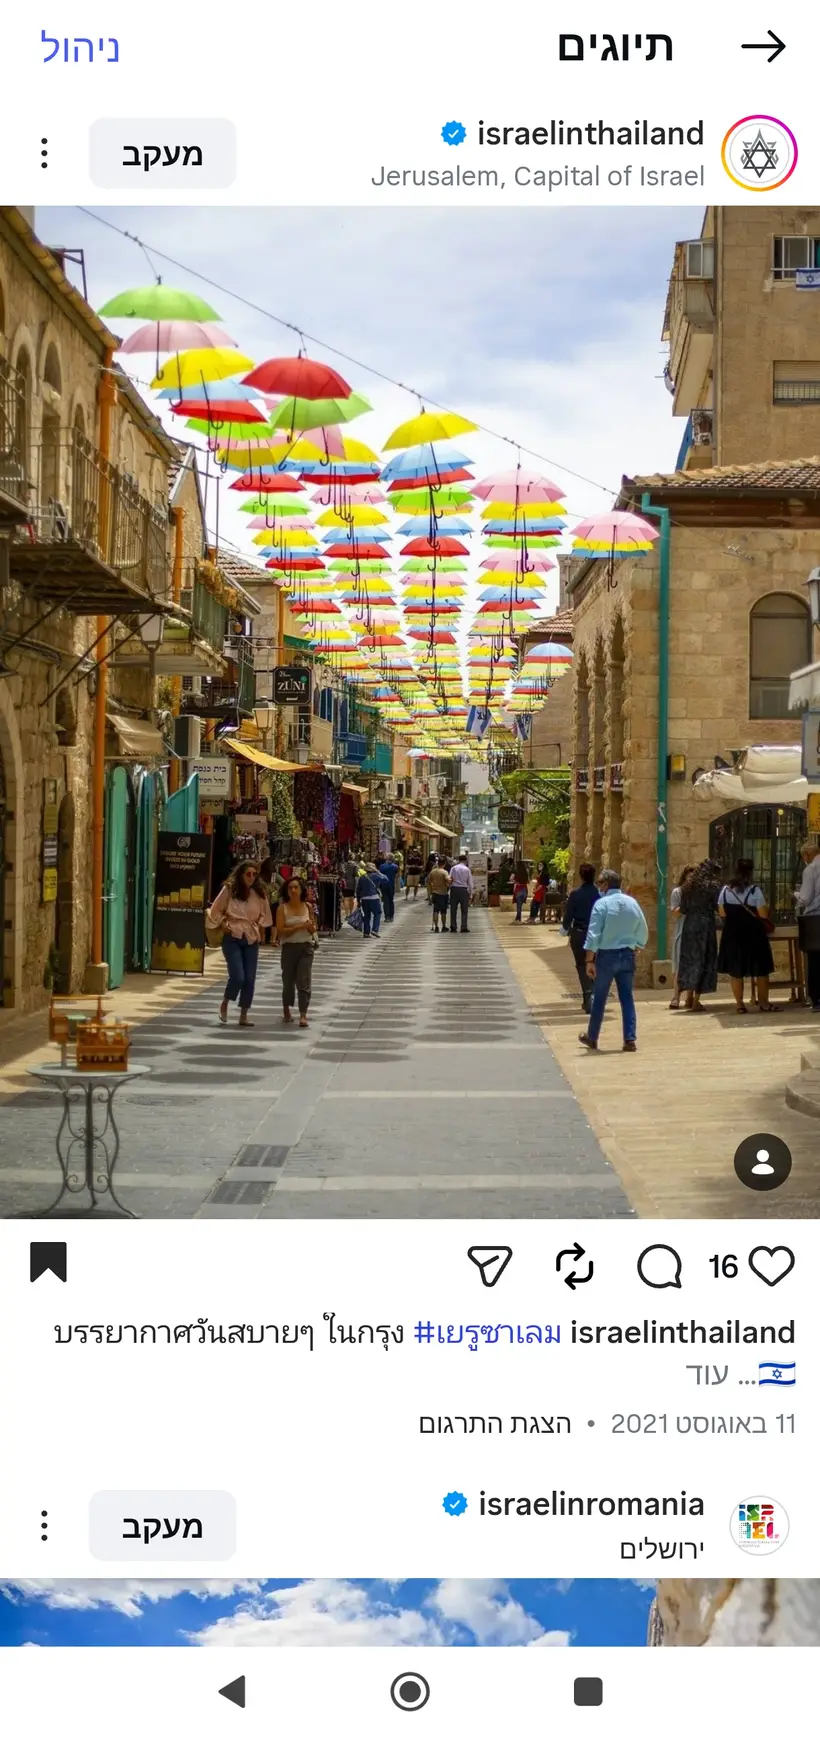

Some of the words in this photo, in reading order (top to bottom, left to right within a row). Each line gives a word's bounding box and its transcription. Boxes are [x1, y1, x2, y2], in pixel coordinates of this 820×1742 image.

[41, 30, 119, 62] ניהול
[559, 34, 672, 61] תיוגים
[478, 120, 704, 145] israelinthailand
[123, 145, 203, 171] מעקב
[371, 165, 506, 190] Jerusalem,
[514, 165, 600, 192] Capital
[607, 165, 633, 187] of
[640, 165, 704, 187] Israel
[192, 765, 211, 773] כנסת
[708, 1253, 738, 1278] 16
[571, 1319, 795, 1344] israelinthailand
[686, 1364, 729, 1386] עוד
[420, 1416, 503, 1434] התרגום
[511, 1416, 571, 1434] הצגת
[611, 1413, 667, 1434] 2021
[676, 1415, 768, 1434] באוגוסט
[775, 1413, 795, 1434] 11
[479, 1490, 704, 1515] israelinromania
[123, 1518, 203, 1545] מעקב
[620, 1536, 704, 1560] ירושלים
